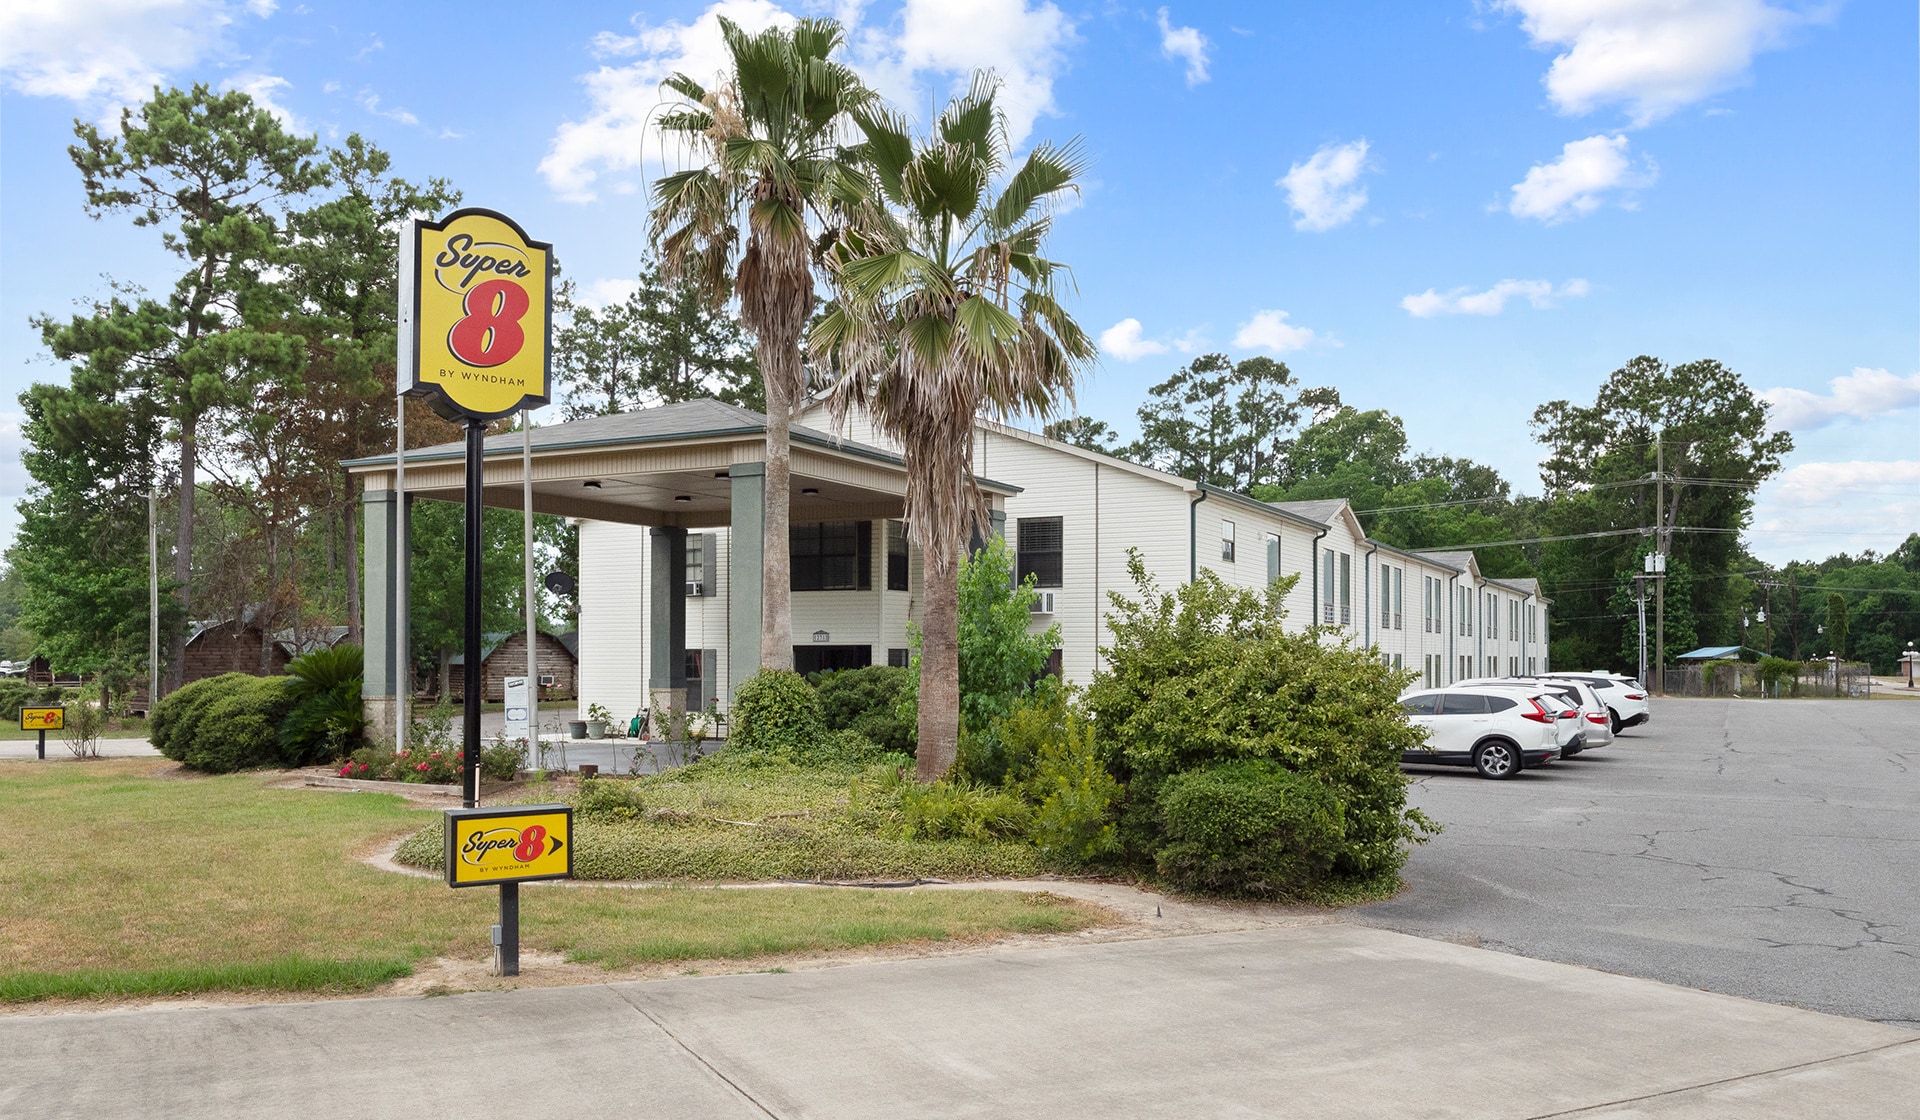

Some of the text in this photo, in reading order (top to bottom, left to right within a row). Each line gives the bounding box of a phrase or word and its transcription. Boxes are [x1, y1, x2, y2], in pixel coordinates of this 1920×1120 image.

[435, 233, 531, 289] Super
[447, 279, 530, 368] 8
[439, 369, 525, 387] BY WYNDHAM
[462, 825, 547, 863] Super 8
[492, 863, 530, 872] WYNDHAM
